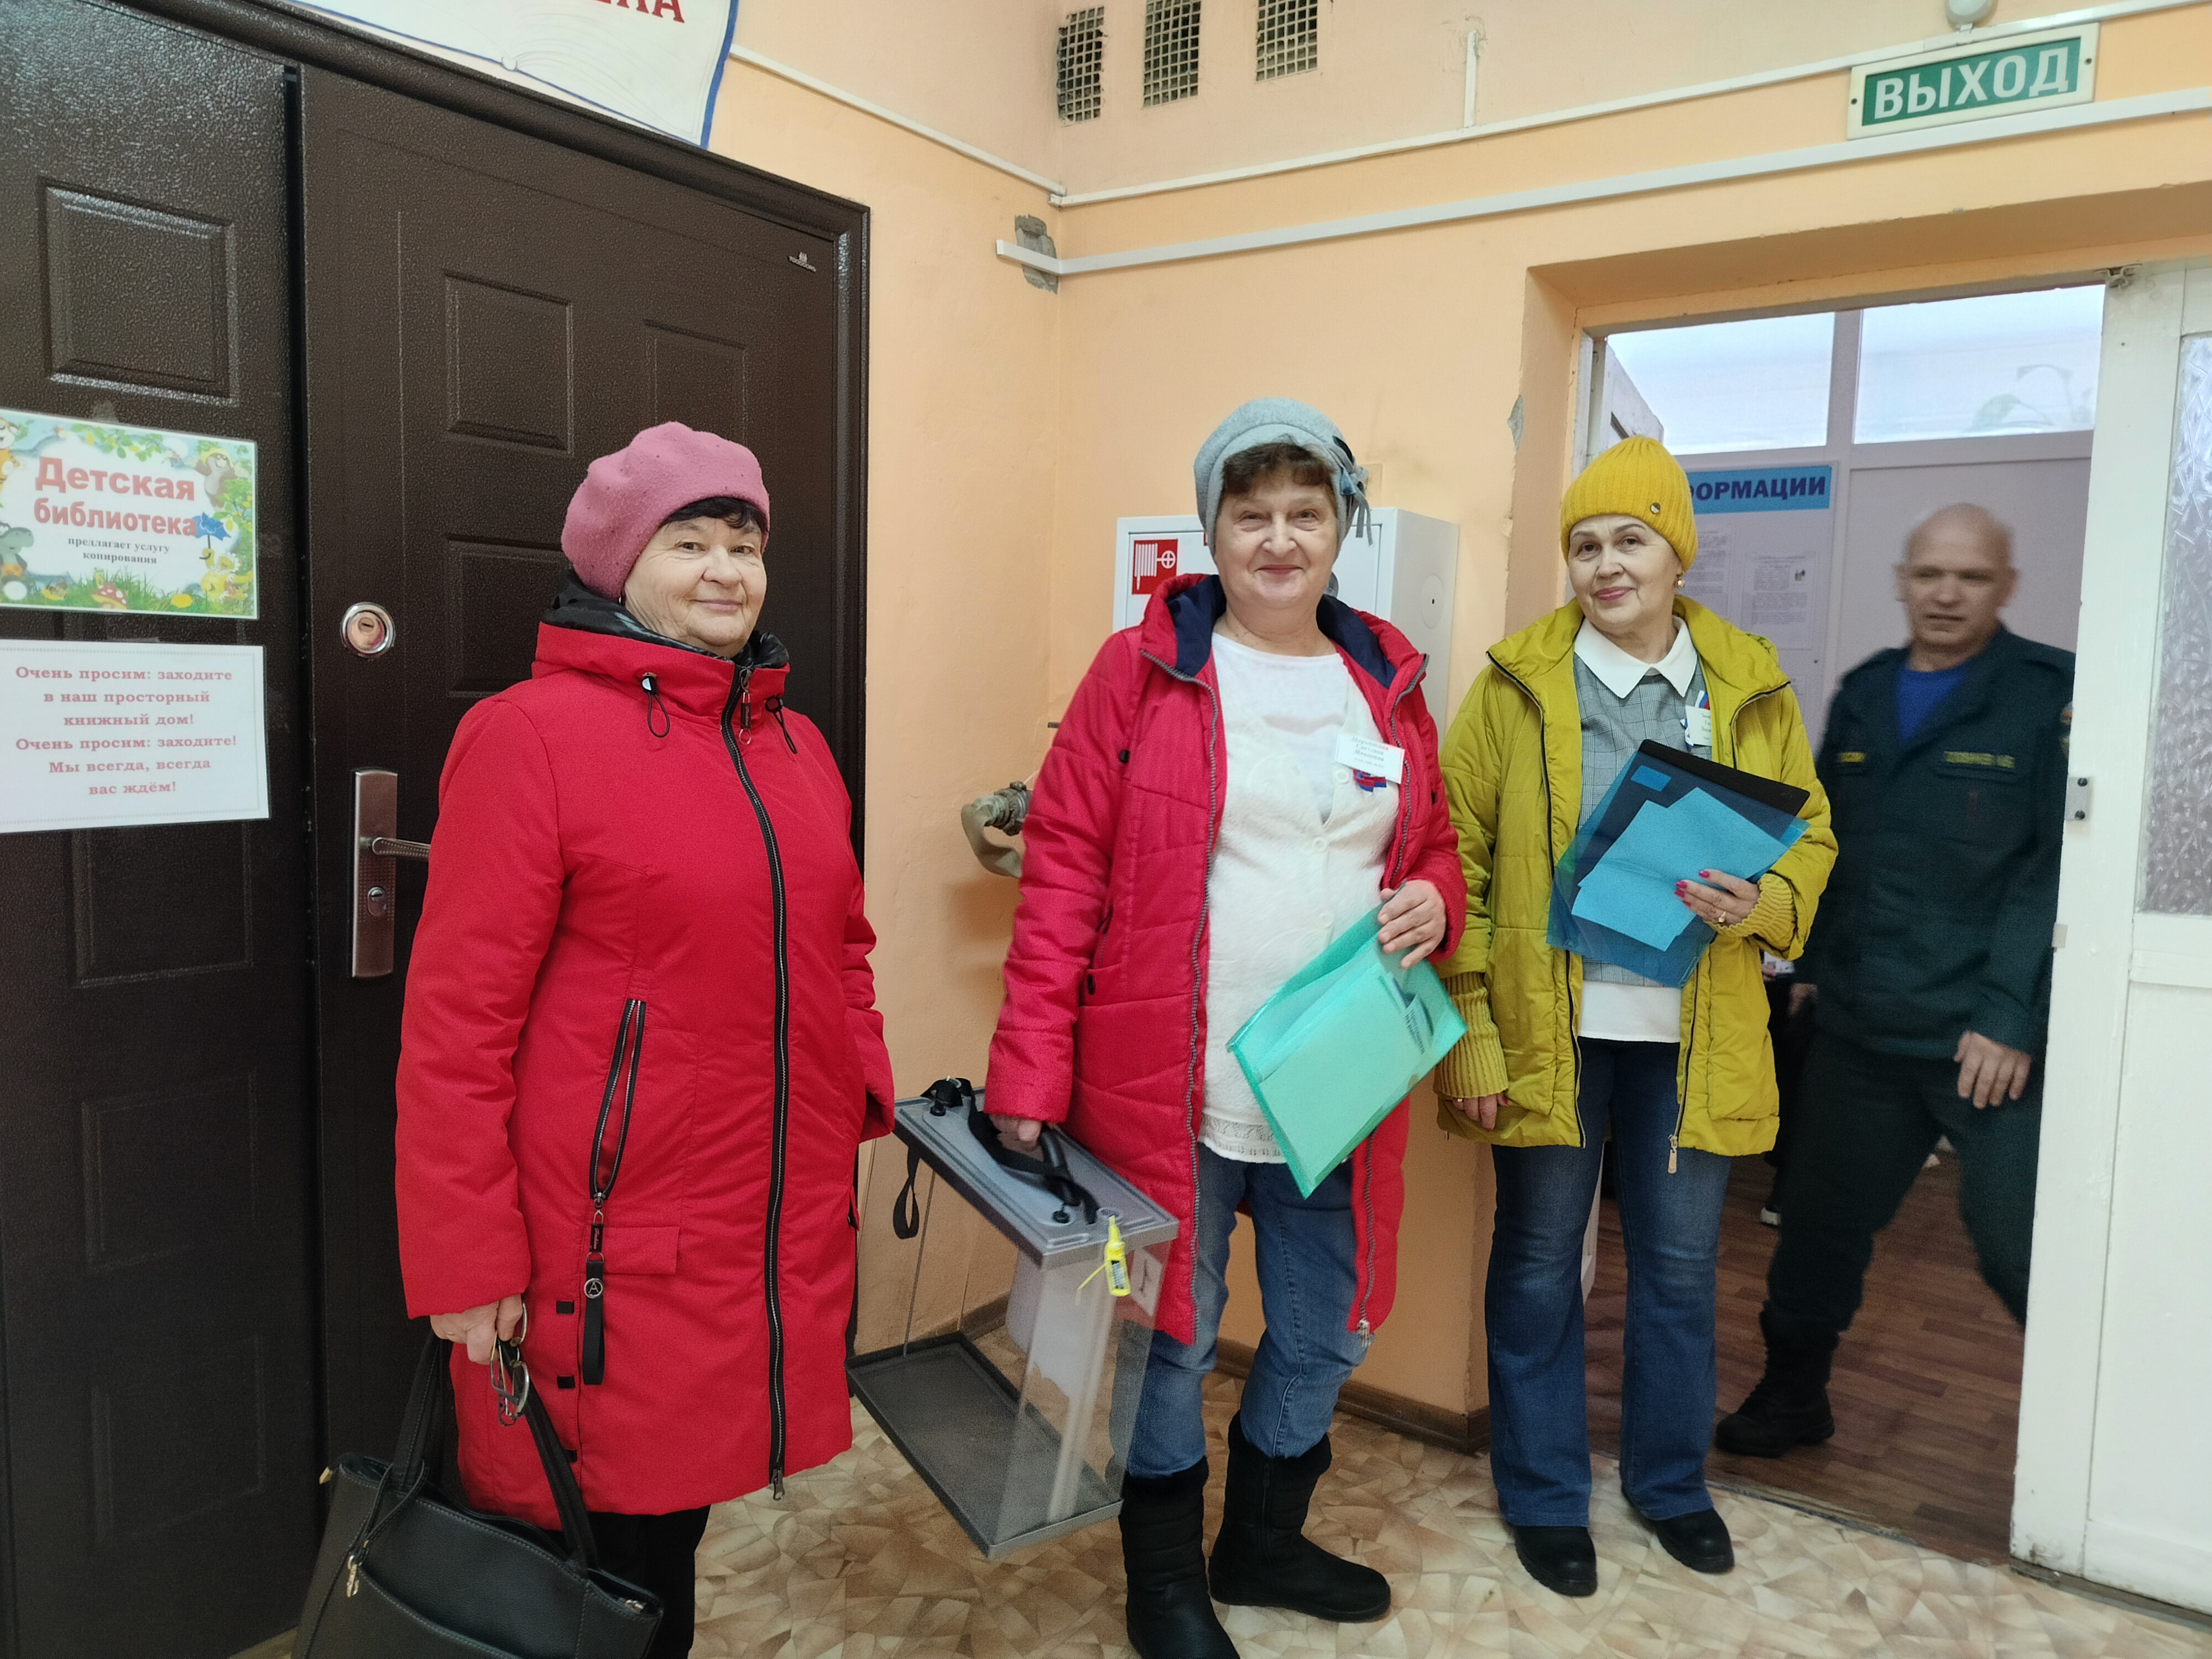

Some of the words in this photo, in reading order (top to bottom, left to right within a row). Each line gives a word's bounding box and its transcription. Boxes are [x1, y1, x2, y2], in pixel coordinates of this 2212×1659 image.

[1874, 47, 2069, 120] ВЫХОД
[35, 456, 194, 500] Детская
[1689, 477, 1826, 501] ОРМАЦИИ
[34, 498, 196, 536] библиотека
[68, 537, 131, 549] предлагает
[134, 541, 170, 554] услугу
[83, 552, 157, 564] копирования
[15, 666, 73, 679] Очень
[79, 669, 151, 681] просим:
[158, 670, 233, 681] заходите
[44, 693, 54, 703] в
[60, 693, 97, 703] наш
[104, 691, 210, 705] просторный
[64, 713, 150, 726] книжный
[155, 714, 194, 726] дом!
[15, 739, 73, 750] Очень
[80, 738, 151, 751] просим:
[157, 735, 237, 748] заходите!
[49, 761, 80, 773] Мы
[86, 762, 150, 773] всегда,
[156, 759, 211, 770] всегда
[89, 785, 117, 795] вас
[123, 781, 176, 794] ждём!
